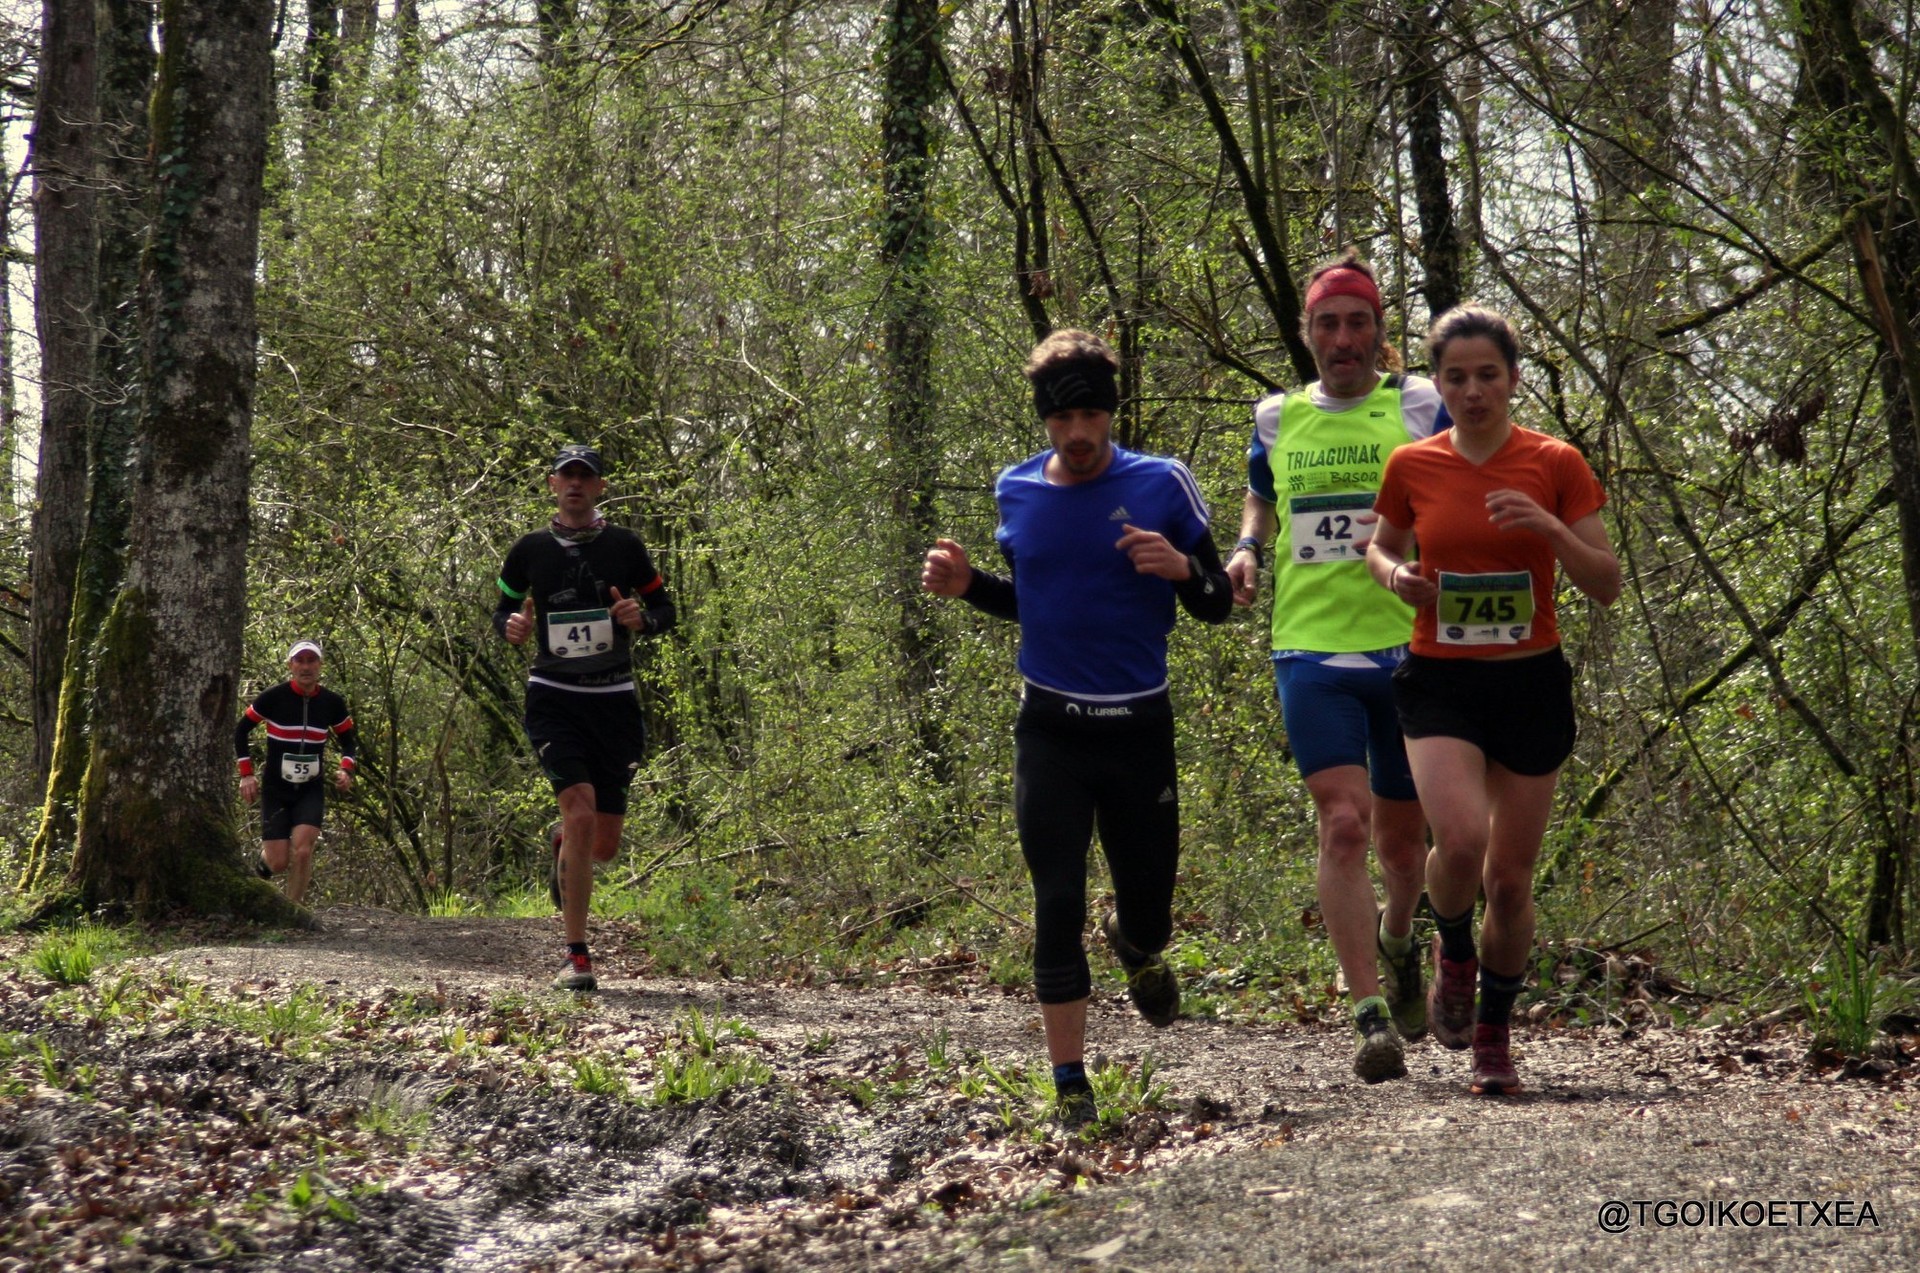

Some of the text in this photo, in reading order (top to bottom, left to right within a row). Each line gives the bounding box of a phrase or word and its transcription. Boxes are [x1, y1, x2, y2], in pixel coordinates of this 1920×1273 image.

[1287, 443, 1380, 471] TRILAGUNAK
[1315, 514, 1352, 541] 42
[1455, 595, 1516, 623] 745
[567, 625, 592, 643] 41
[294, 763, 310, 775] 55
